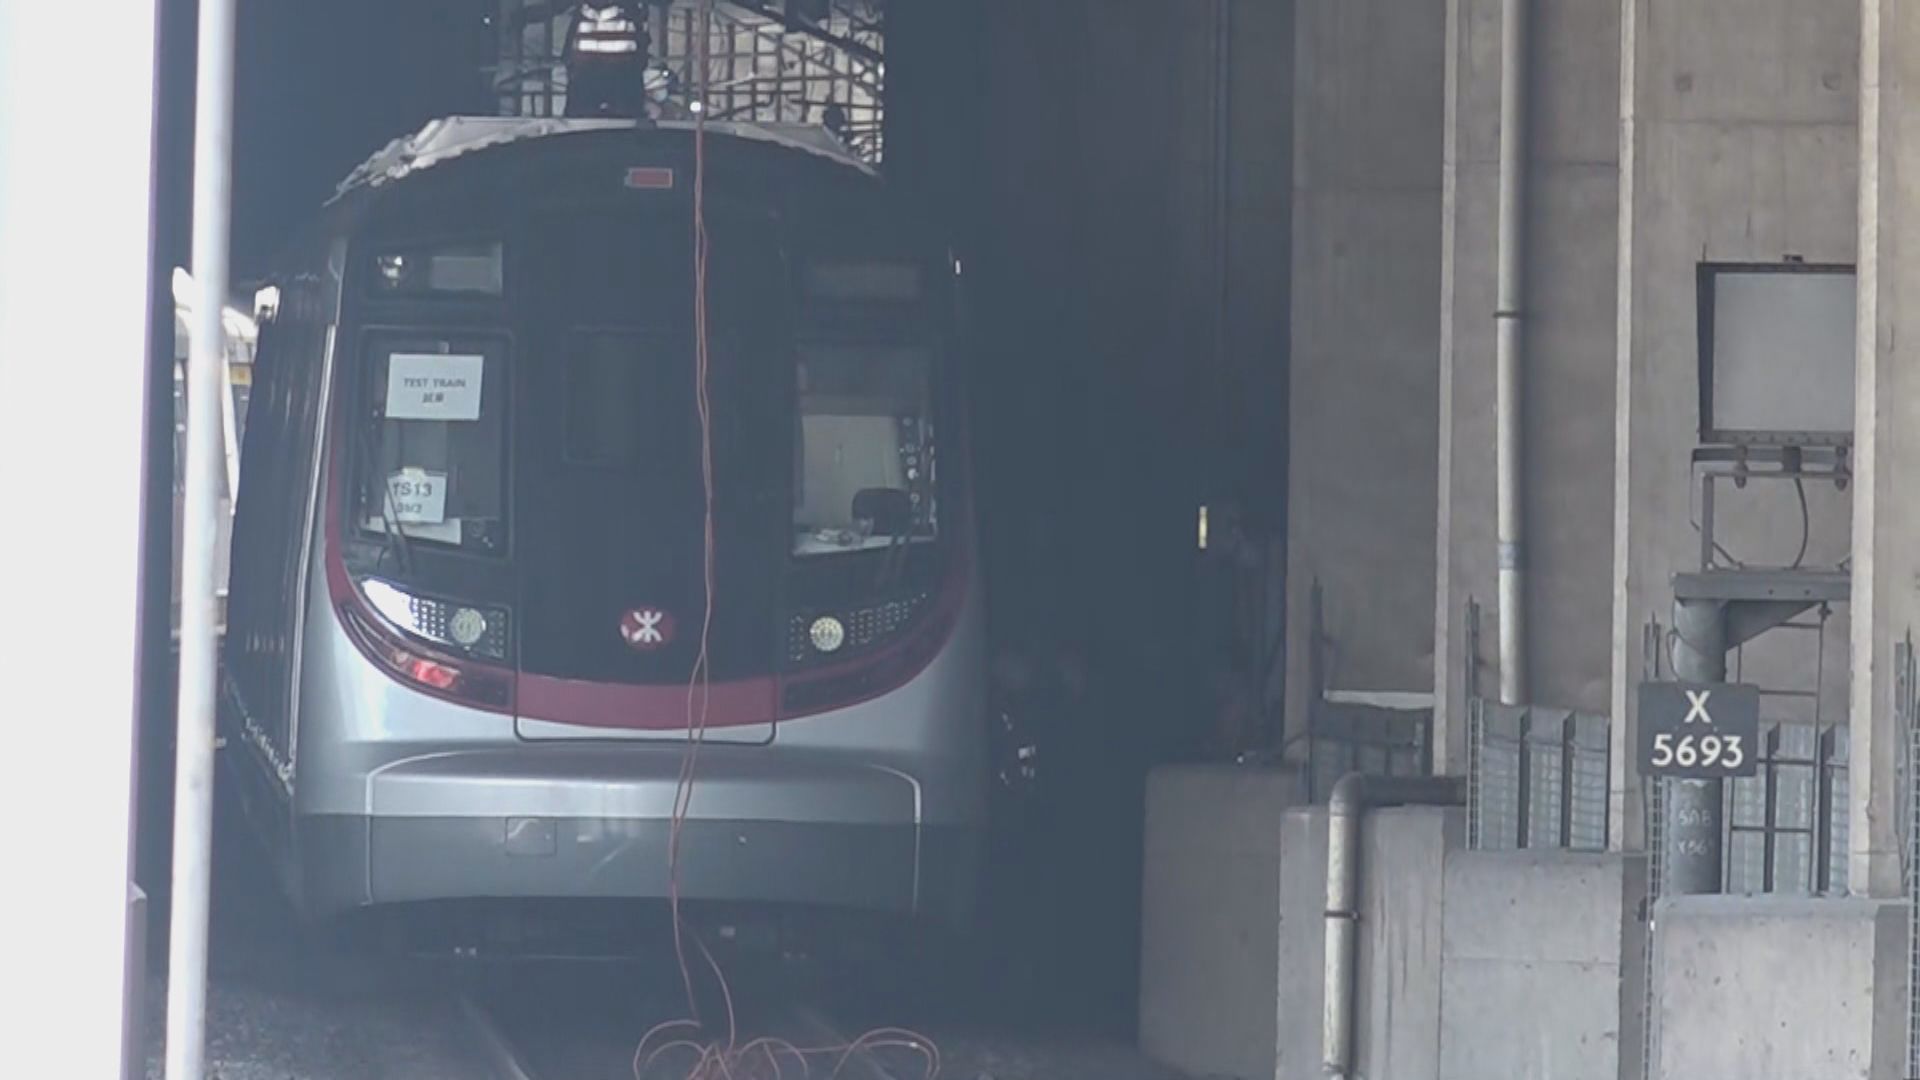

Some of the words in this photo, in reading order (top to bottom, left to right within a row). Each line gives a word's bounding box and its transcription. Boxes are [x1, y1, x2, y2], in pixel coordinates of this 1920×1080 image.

[404, 378, 428, 388] TEST
[433, 378, 466, 388] TRAIN
[1684, 690, 1712, 723] X
[1651, 733, 1743, 768] 5693
